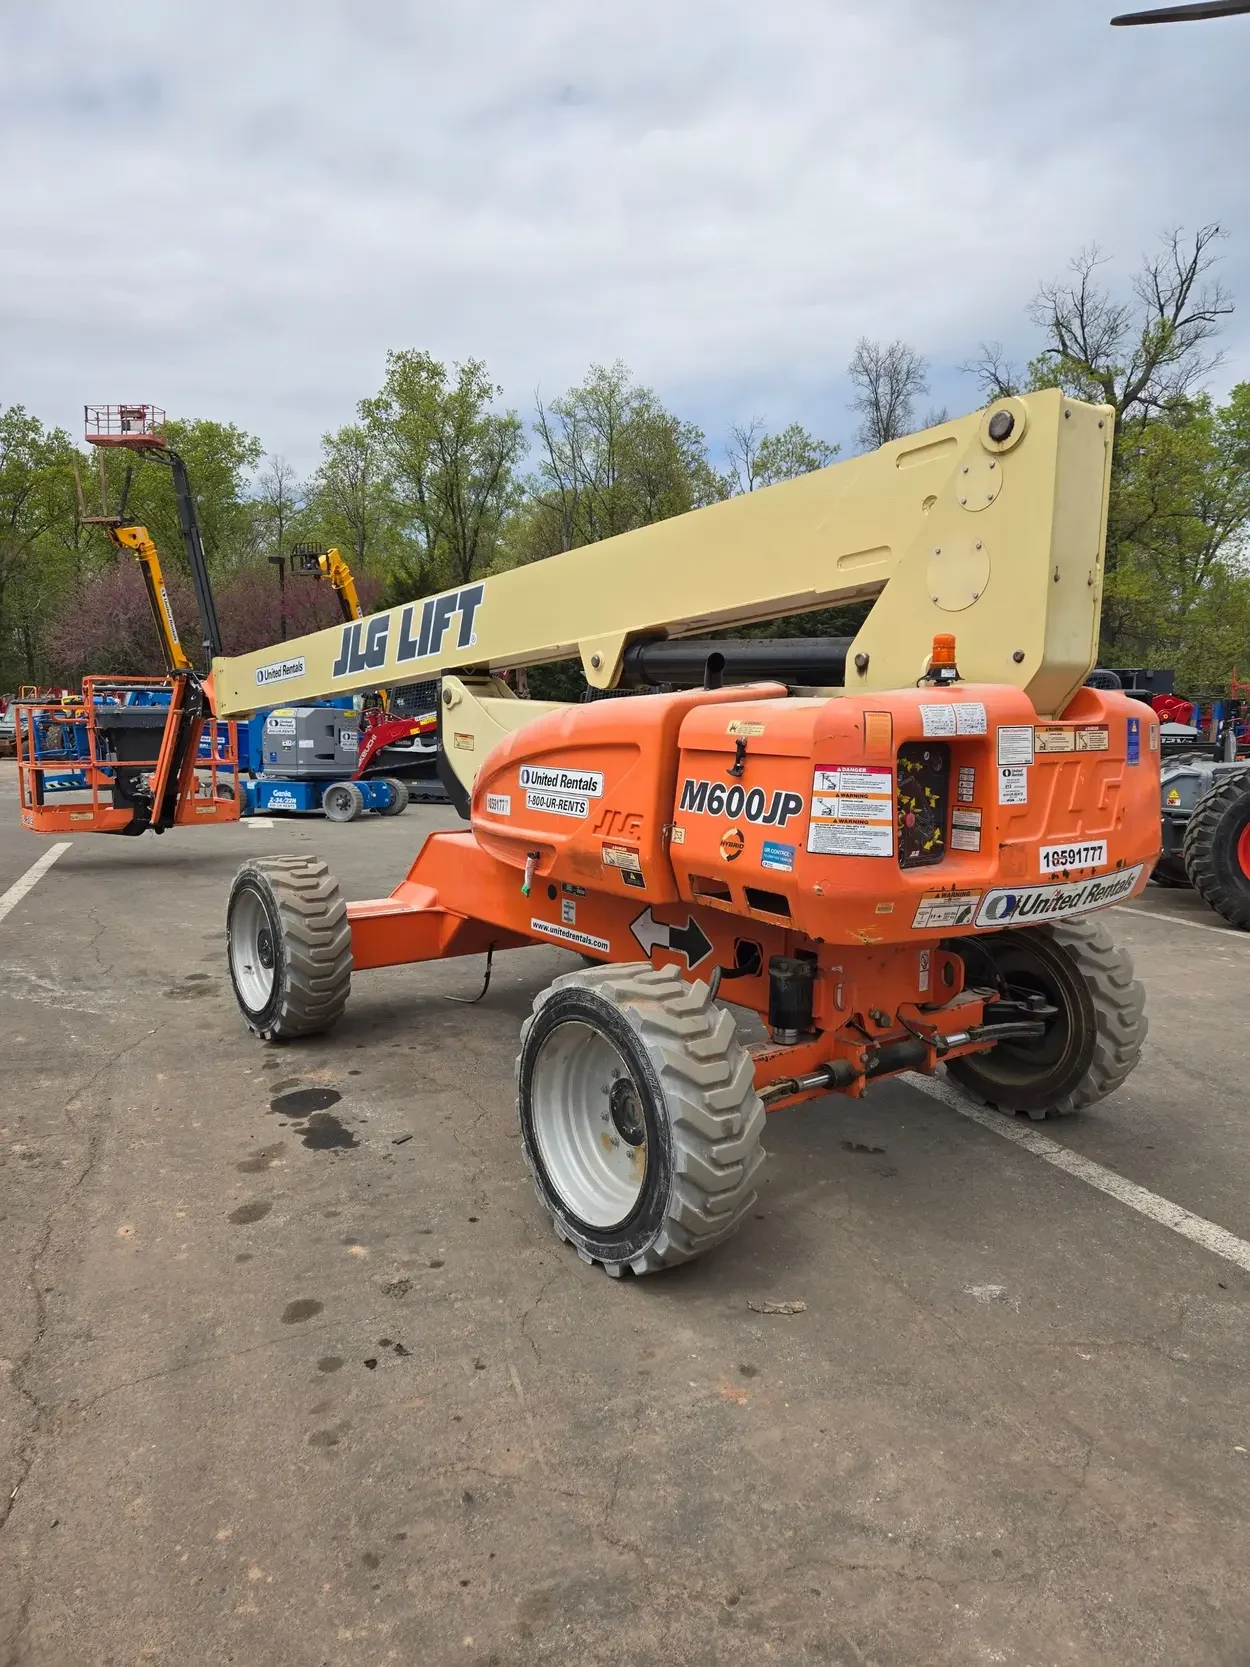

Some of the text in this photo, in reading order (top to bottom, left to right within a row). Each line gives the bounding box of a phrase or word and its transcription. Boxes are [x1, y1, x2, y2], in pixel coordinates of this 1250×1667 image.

[332, 584, 485, 678] JLG LIFT
[264, 662, 303, 681] United Rentals
[530, 771, 598, 792] United Rentals
[273, 789, 292, 798] Genie
[527, 794, 586, 814] 1-800-UR-RENTS
[679, 778, 804, 827] M600JP
[1003, 758, 1126, 844] JLG
[592, 809, 644, 844] JLG
[719, 840, 745, 850] HYBRID
[1043, 845, 1104, 868] 10591777
[941, 890, 971, 898] WARNING
[1018, 872, 1135, 917] United Rentals
[532, 921, 609, 950] www.unitedrentals.com
